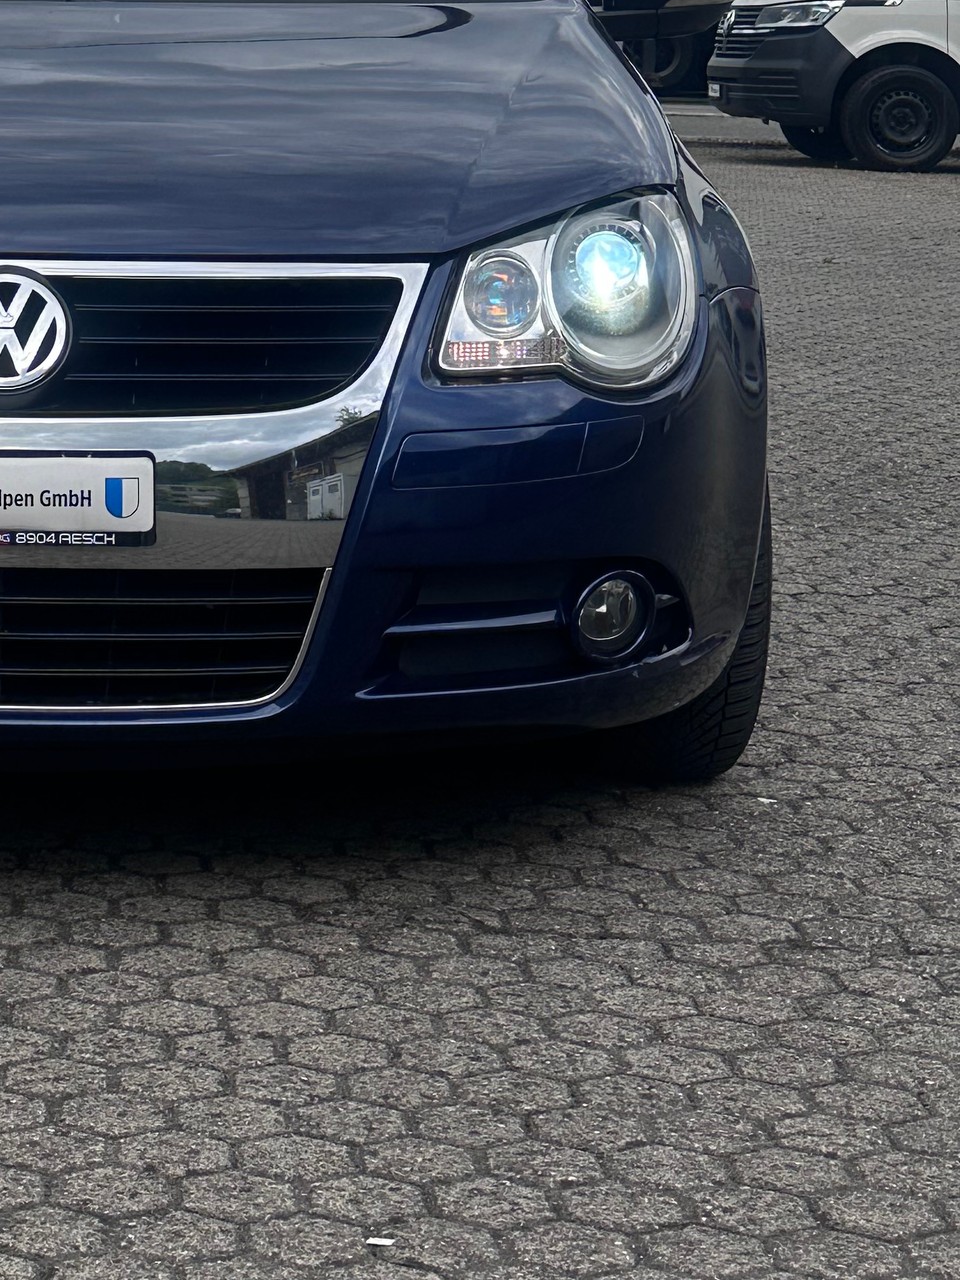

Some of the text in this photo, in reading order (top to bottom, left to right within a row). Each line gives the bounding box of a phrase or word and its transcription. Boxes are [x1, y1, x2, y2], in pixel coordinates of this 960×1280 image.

[39, 489, 92, 508] GmbH
[15, 532, 56, 544] 8904
[58, 532, 116, 545] AESCH
